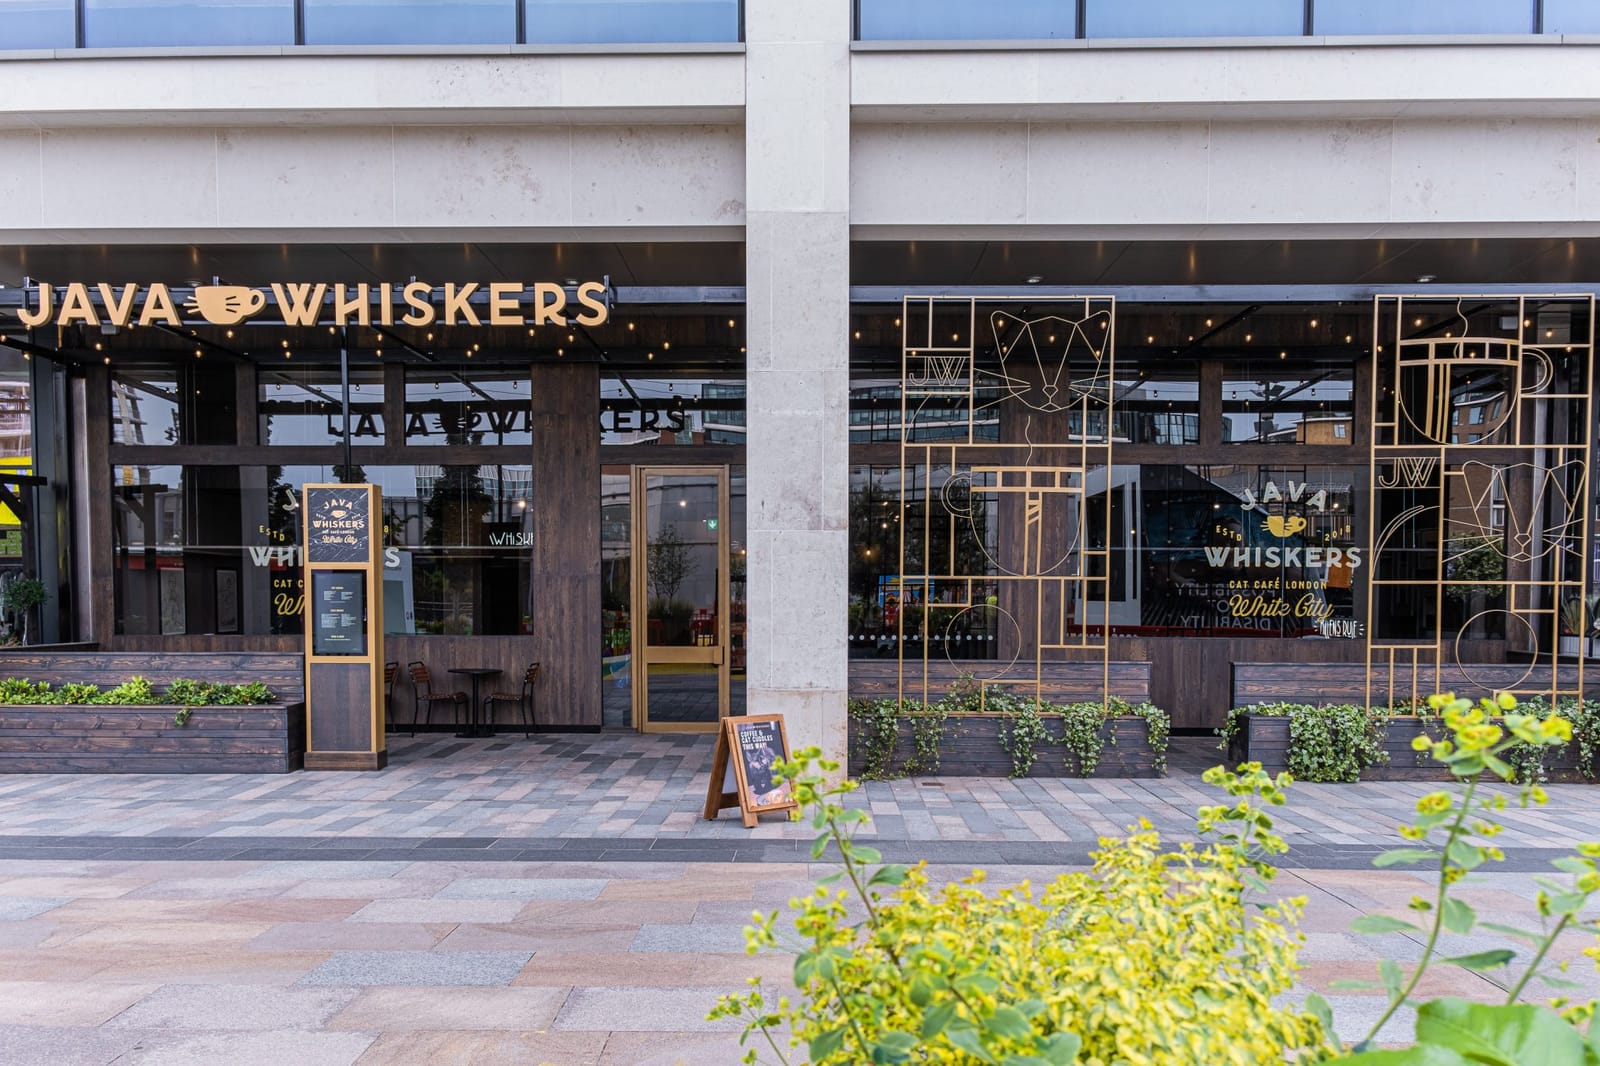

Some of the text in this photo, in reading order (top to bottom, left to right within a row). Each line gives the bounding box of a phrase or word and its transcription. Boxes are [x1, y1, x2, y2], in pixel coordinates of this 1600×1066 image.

[17, 282, 609, 327] JAVA WHISKERS
[324, 499, 353, 510] JAVA
[1240, 480, 1327, 512] JAVA
[312, 520, 366, 529] WHISKERS
[259, 525, 286, 542] ESTD
[1216, 525, 1351, 542] ESTD 2018
[1204, 546, 1362, 568] WHISKERS
[273, 579, 292, 588] CAT
[1229, 577, 1327, 590] CAT CAFÉ LONDON
[1229, 594, 1291, 617] White
[1294, 592, 1335, 623] City
